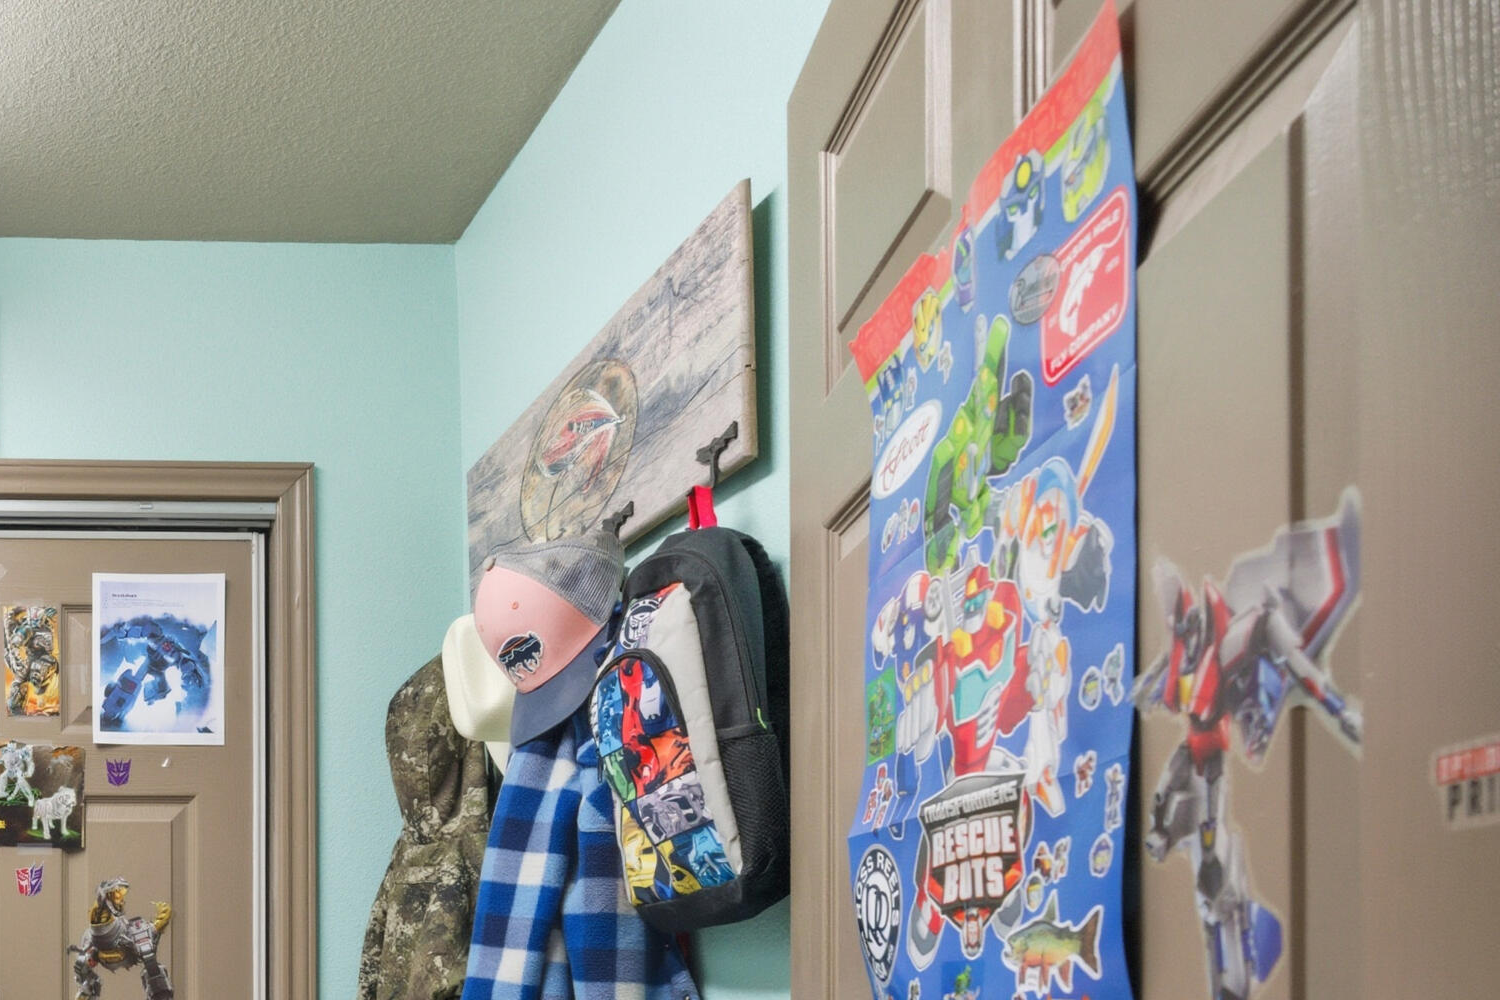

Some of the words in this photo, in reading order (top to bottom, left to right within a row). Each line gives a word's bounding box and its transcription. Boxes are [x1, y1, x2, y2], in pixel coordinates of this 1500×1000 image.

[931, 813, 1018, 869] RESCUE
[876, 850, 900, 927] REELS
[942, 855, 1005, 905] BOTS
